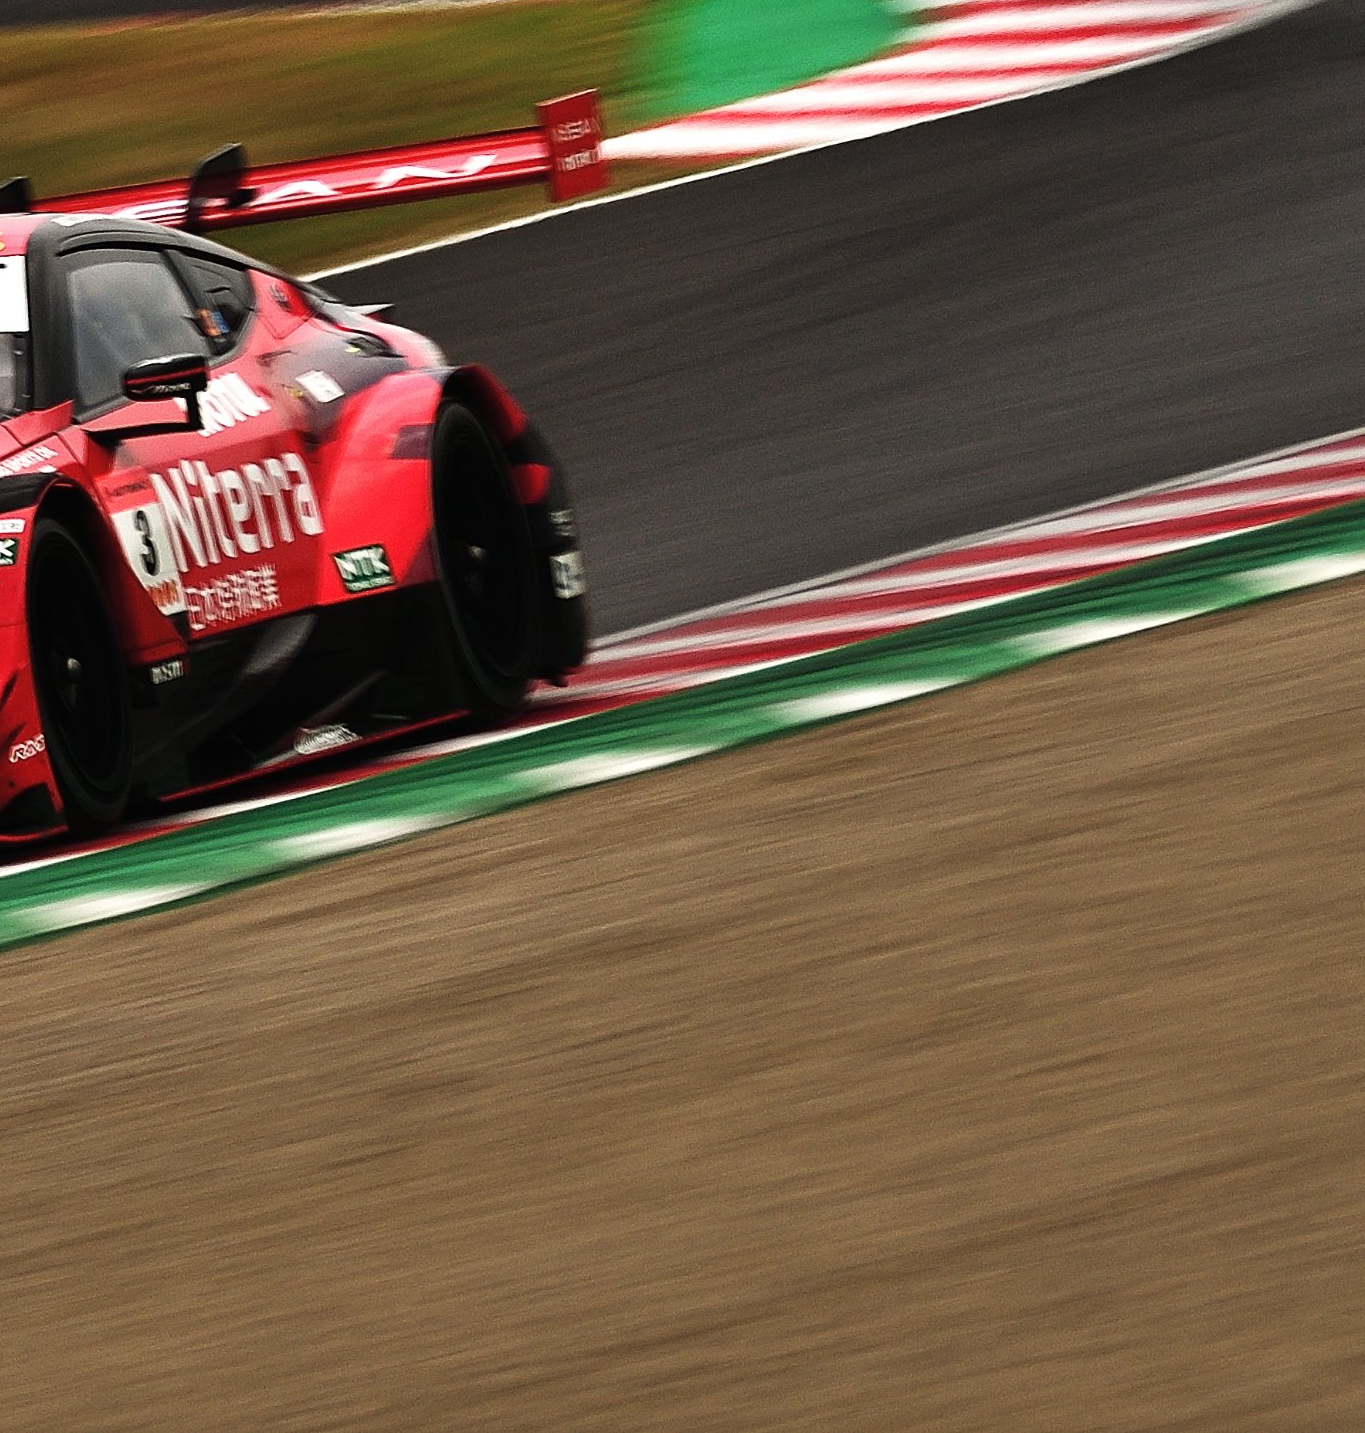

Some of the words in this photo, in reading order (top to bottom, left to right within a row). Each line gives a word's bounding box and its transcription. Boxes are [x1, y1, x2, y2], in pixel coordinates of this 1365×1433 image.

[134, 510, 160, 576] 3
[149, 452, 324, 573] Niterra
[333, 547, 390, 581] NTK
